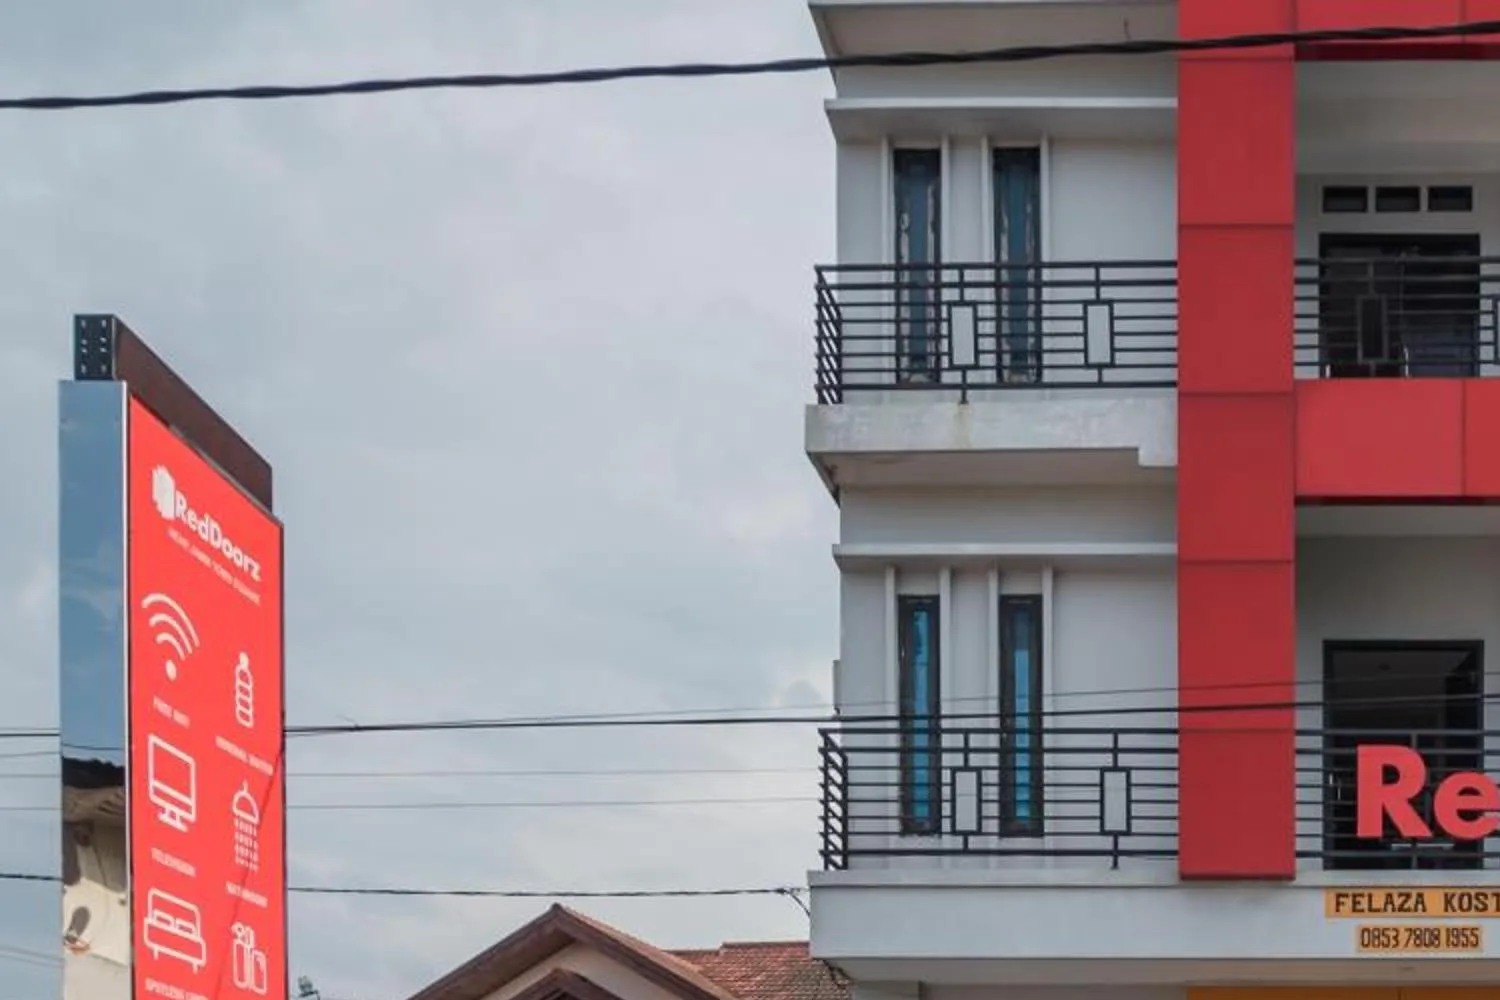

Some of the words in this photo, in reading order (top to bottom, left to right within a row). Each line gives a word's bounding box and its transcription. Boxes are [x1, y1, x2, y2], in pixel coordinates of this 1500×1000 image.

[175, 489, 262, 582] RedDoorz
[1334, 891, 1428, 914] FELAZA
[1360, 926, 1400, 949] 0853
[1403, 926, 1441, 949] 7808
[1445, 926, 1481, 949] 1955
